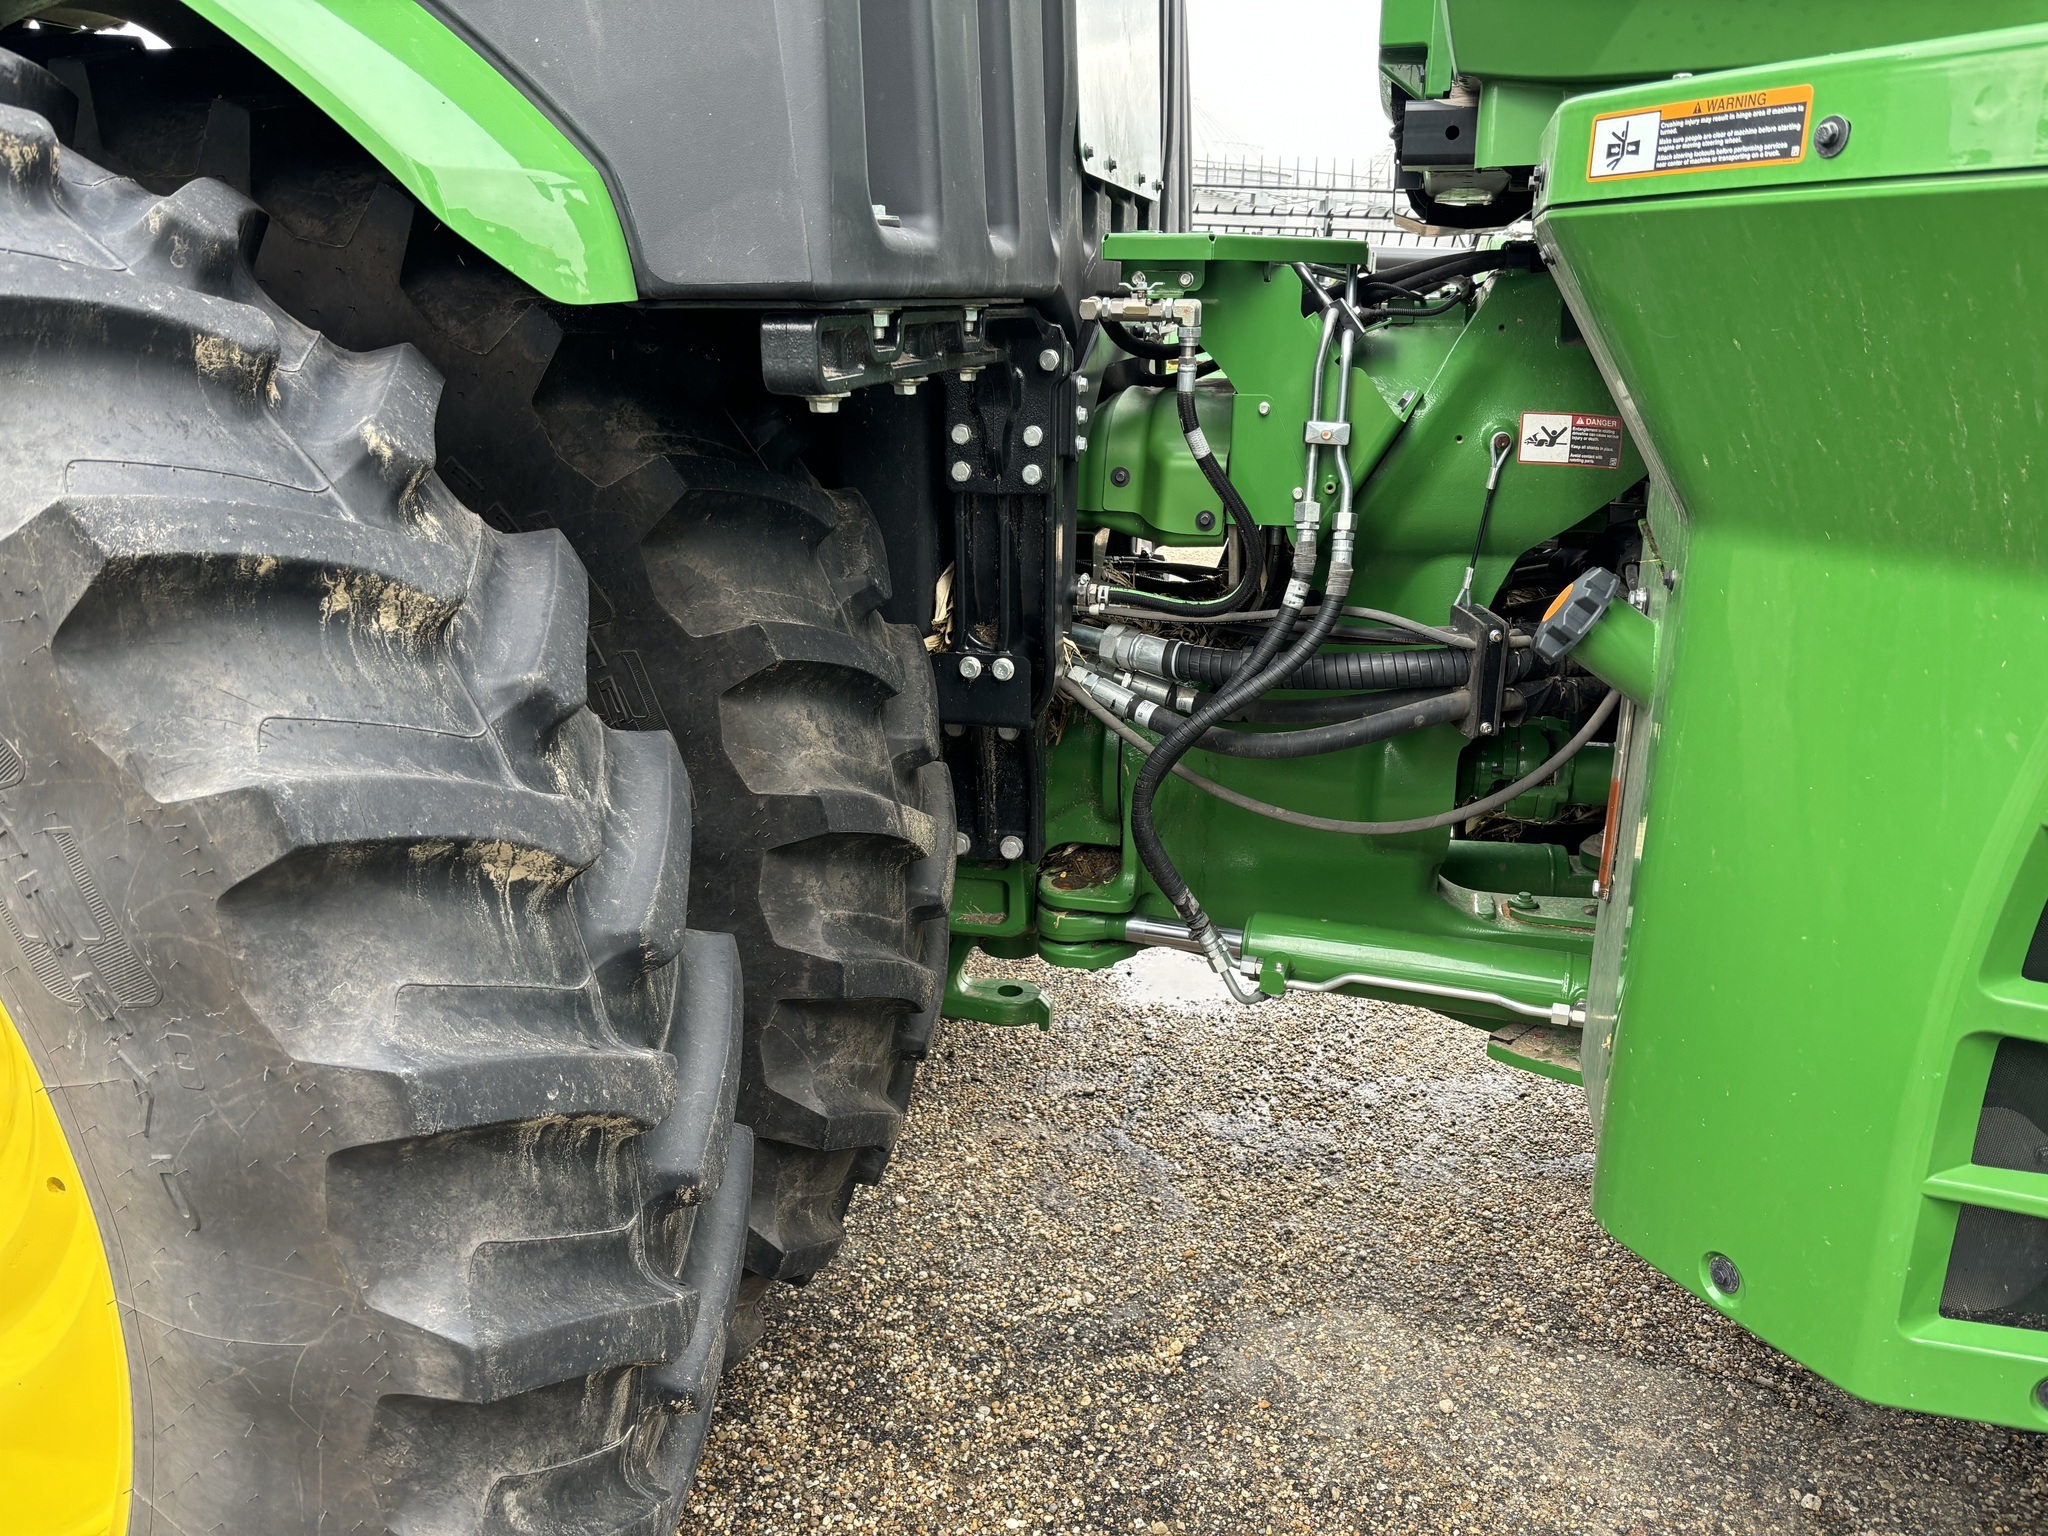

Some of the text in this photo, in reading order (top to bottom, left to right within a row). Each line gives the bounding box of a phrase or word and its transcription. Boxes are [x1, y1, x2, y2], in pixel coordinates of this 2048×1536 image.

[1707, 92, 1767, 112] WARNING
[1661, 121, 1684, 129] Crushing
[1772, 106, 1797, 114] machine
[1778, 123, 1801, 131] starting
[1734, 145, 1763, 154] performing
[1718, 153, 1751, 161] transporting
[1586, 418, 1616, 427] DANGER
